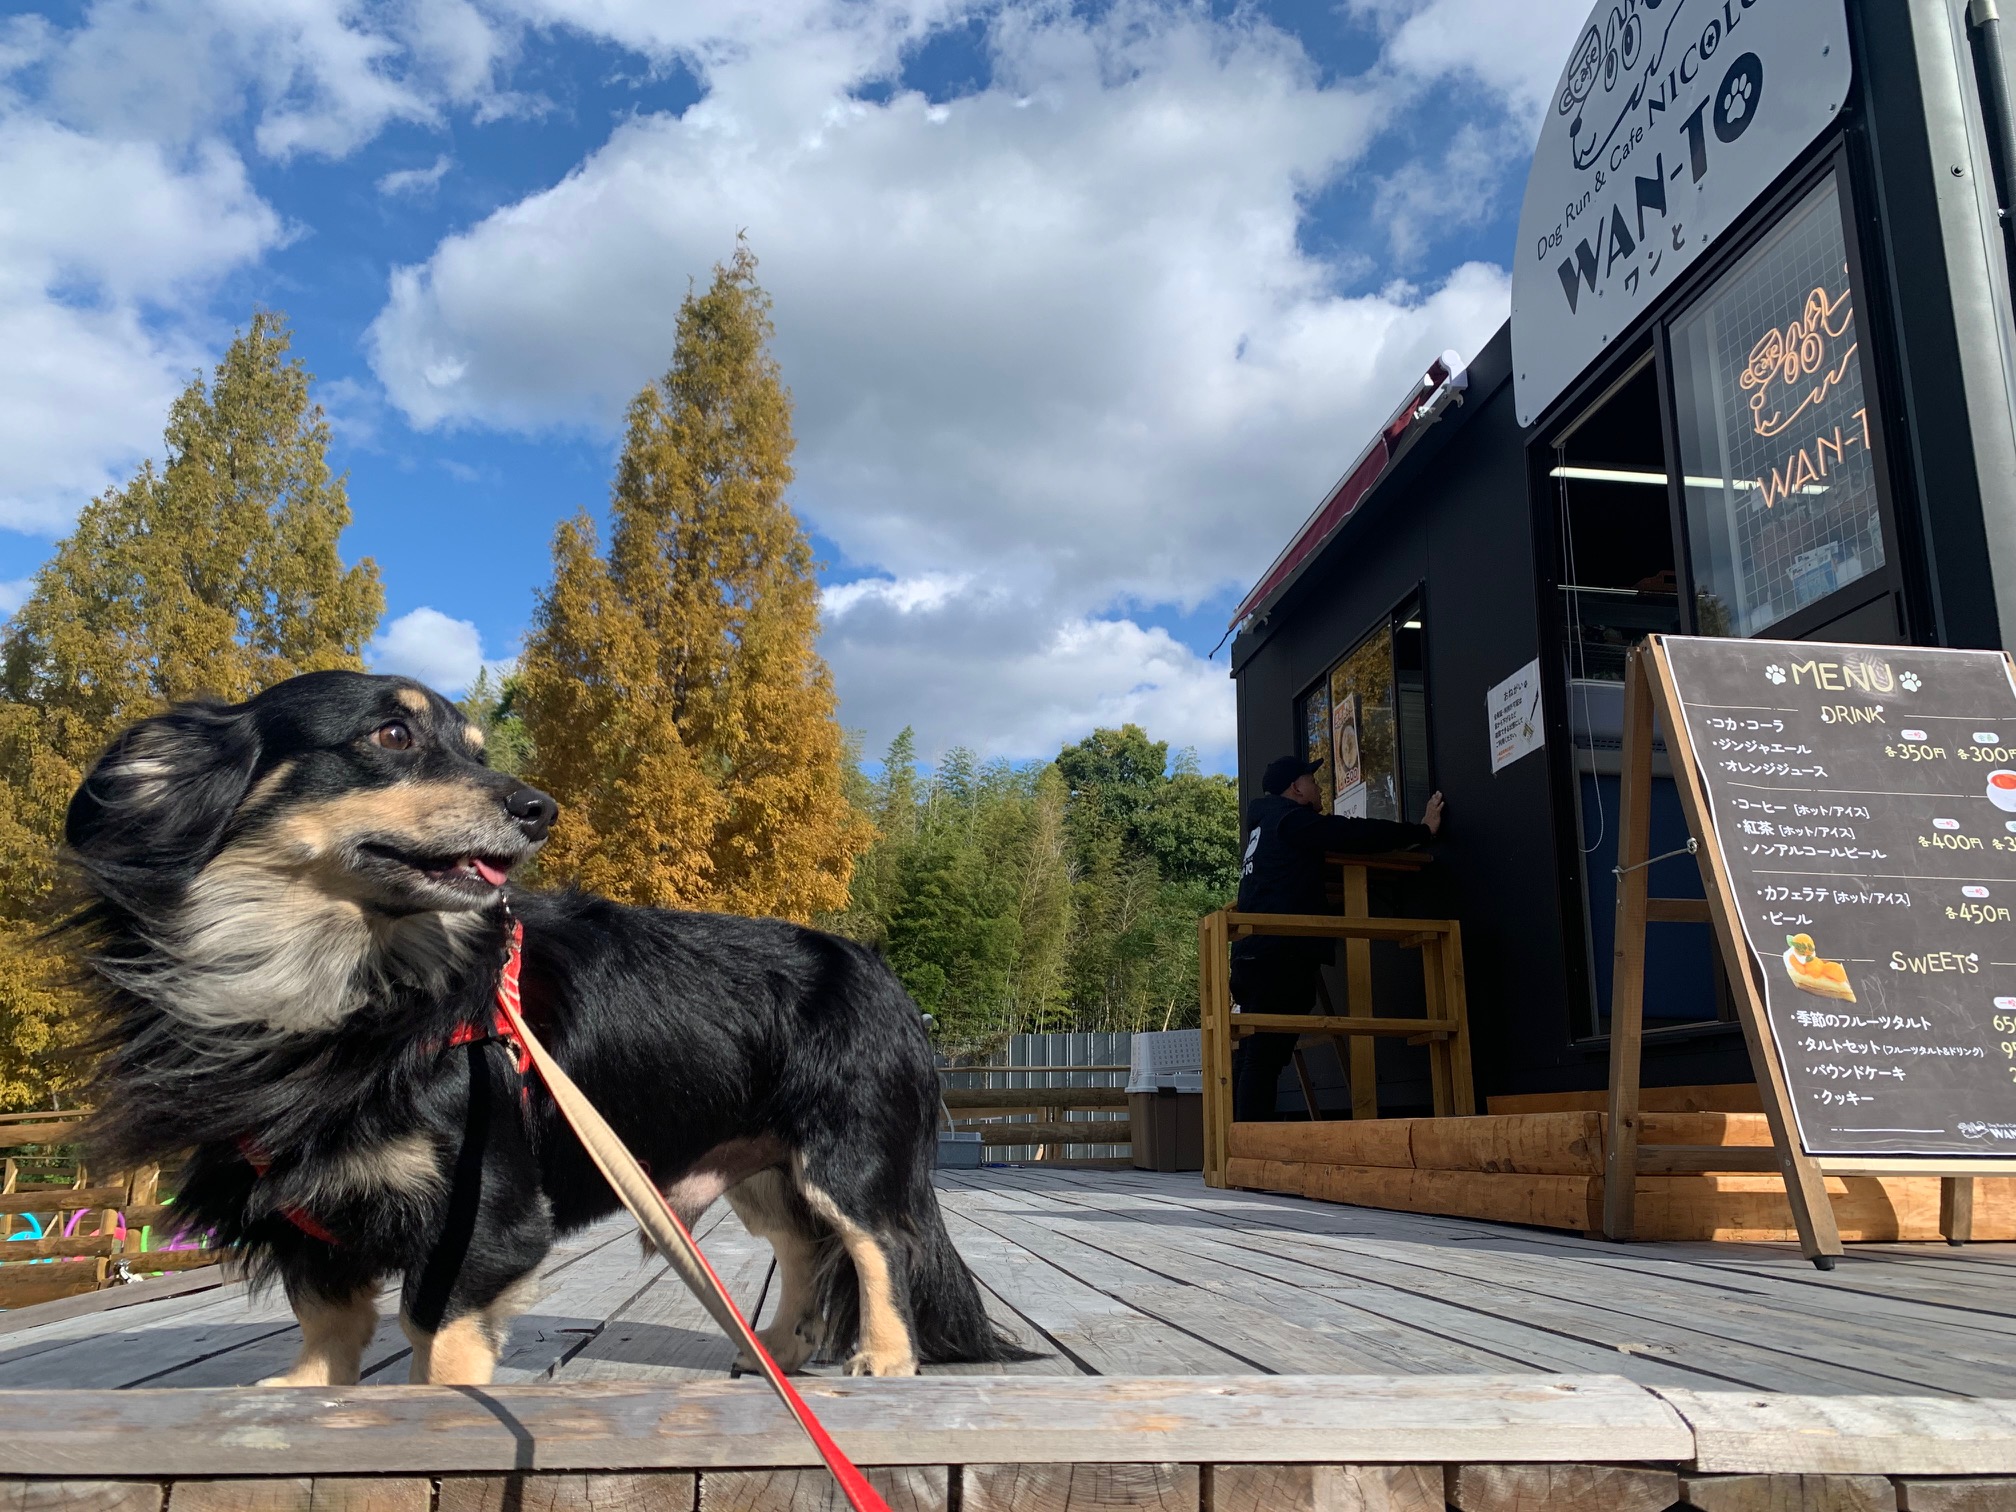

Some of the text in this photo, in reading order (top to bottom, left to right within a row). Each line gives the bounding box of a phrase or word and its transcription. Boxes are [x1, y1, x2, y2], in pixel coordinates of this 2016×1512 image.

[1557, 51, 1763, 315] WAN-TO
[1537, 223, 1563, 261] Dog
[1565, 191, 1591, 228] Run
[1594, 170, 1606, 193] &
[1610, 126, 1644, 171] Cafe
[1624, 223, 1685, 297] ワンと
[1791, 661, 1894, 693] MENU
[1822, 705, 1886, 725] DRINK
[1885, 744, 1946, 761] 各350円
[1919, 833, 1984, 850] 各400円
[1945, 903, 2010, 923] 各450円
[1993, 1015, 2016, 1033] 65
